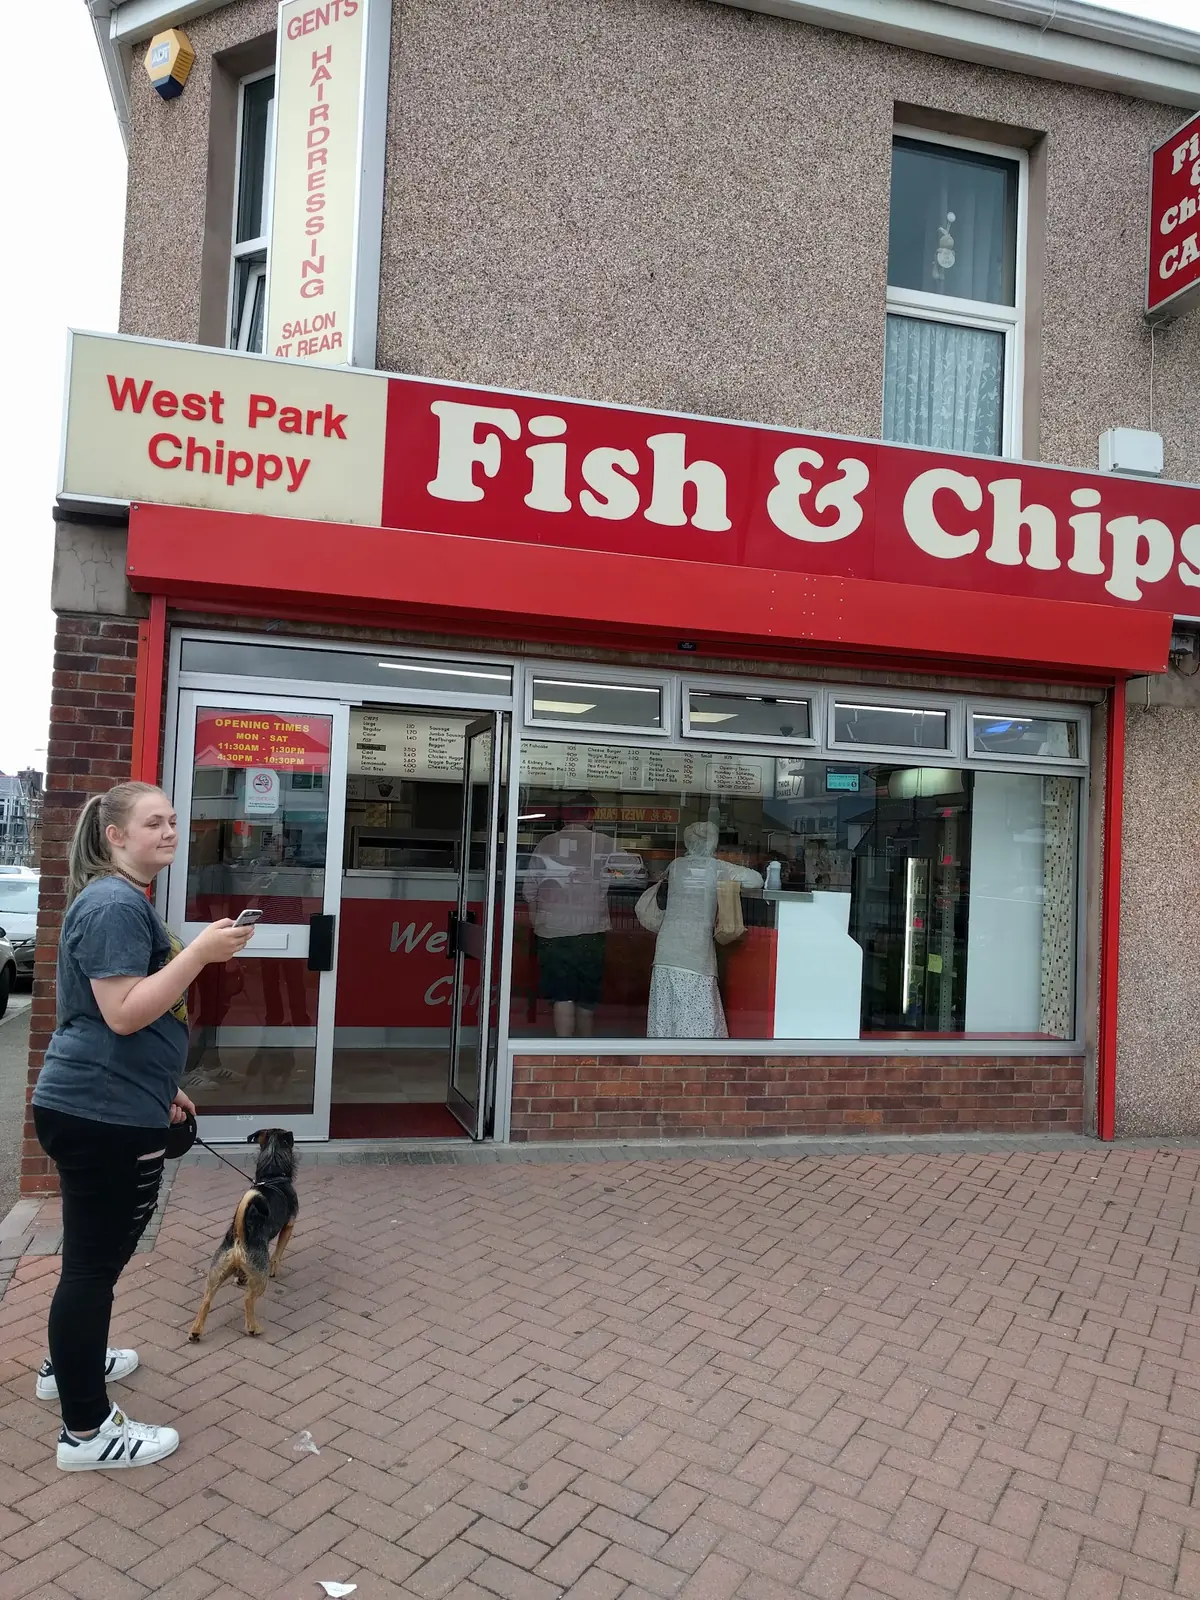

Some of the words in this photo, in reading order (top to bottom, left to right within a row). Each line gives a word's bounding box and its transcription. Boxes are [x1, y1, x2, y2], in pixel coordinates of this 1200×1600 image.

[286, 0, 359, 41] GENTS
[152, 46, 169, 63] ADT
[300, 44, 333, 298] HAIRDRESSING
[282, 311, 336, 340] SALON
[275, 343, 293, 358] AT
[296, 331, 343, 358] REAR
[106, 374, 224, 424] West
[248, 394, 349, 440] Park
[148, 432, 311, 493] Chippy
[426, 400, 732, 532] Fish
[766, 447, 871, 543] &
[215, 718, 270, 730] OPENING
[273, 722, 310, 733] TIMES
[236, 732, 259, 741] MON
[269, 735, 289, 743] SAT
[217, 753, 253, 762] 4:30PM
[263, 756, 305, 765] 10:30PM
[218, 742, 259, 752] 11:30AM
[270, 746, 305, 755] 1:30PM
